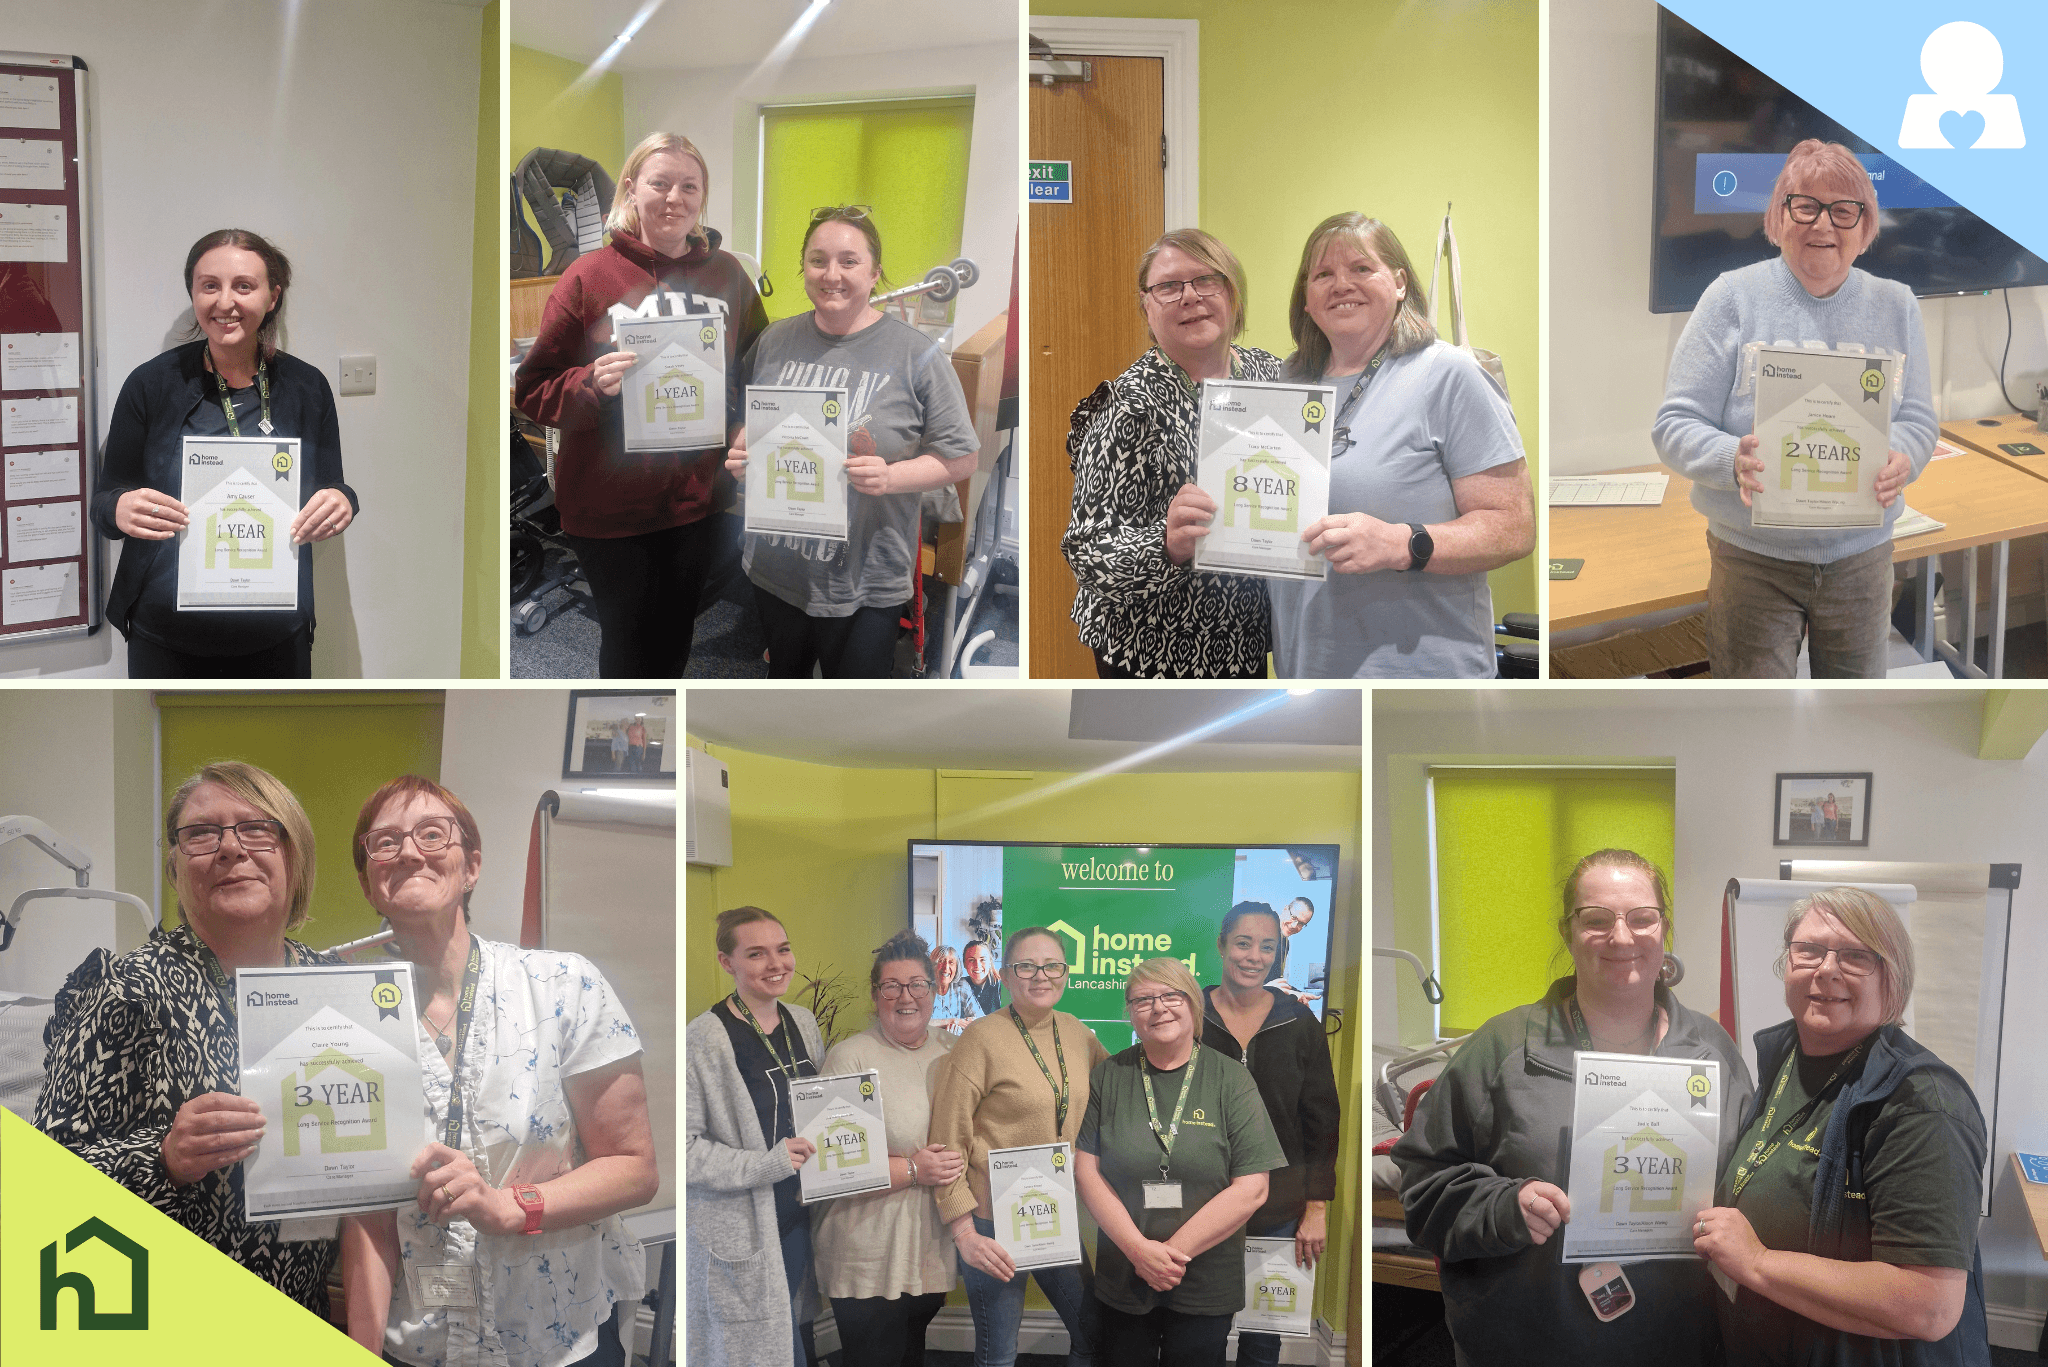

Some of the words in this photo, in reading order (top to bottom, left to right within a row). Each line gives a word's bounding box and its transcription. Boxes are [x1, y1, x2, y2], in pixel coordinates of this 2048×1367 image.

[655, 389, 660, 400] 1
[664, 386, 698, 398] YEAR
[1786, 443, 1800, 458] 2
[1806, 444, 1861, 461] YEARS
[776, 460, 780, 472] 1
[784, 460, 818, 474] YEAR
[1233, 476, 1248, 492] 8
[1253, 477, 1296, 496] YEAR
[217, 524, 222, 538] 1
[228, 524, 266, 538] YEAR
[1062, 856, 1149, 881] welcome
[1154, 860, 1174, 881] to
[1092, 924, 1172, 952] home
[1092, 951, 1200, 976] instd.
[294, 1086, 314, 1106] 3
[320, 1082, 381, 1105] YEAR
[823, 1138, 833, 1148] 1
[836, 1132, 866, 1146] YEAR
[1613, 1156, 1629, 1174] 3
[1636, 1157, 1683, 1175] YEAR
[1017, 1207, 1027, 1216] 4
[1029, 1203, 1057, 1216] YEAR
[1259, 1286, 1268, 1294] 9
[1271, 1287, 1295, 1295] YEAR
